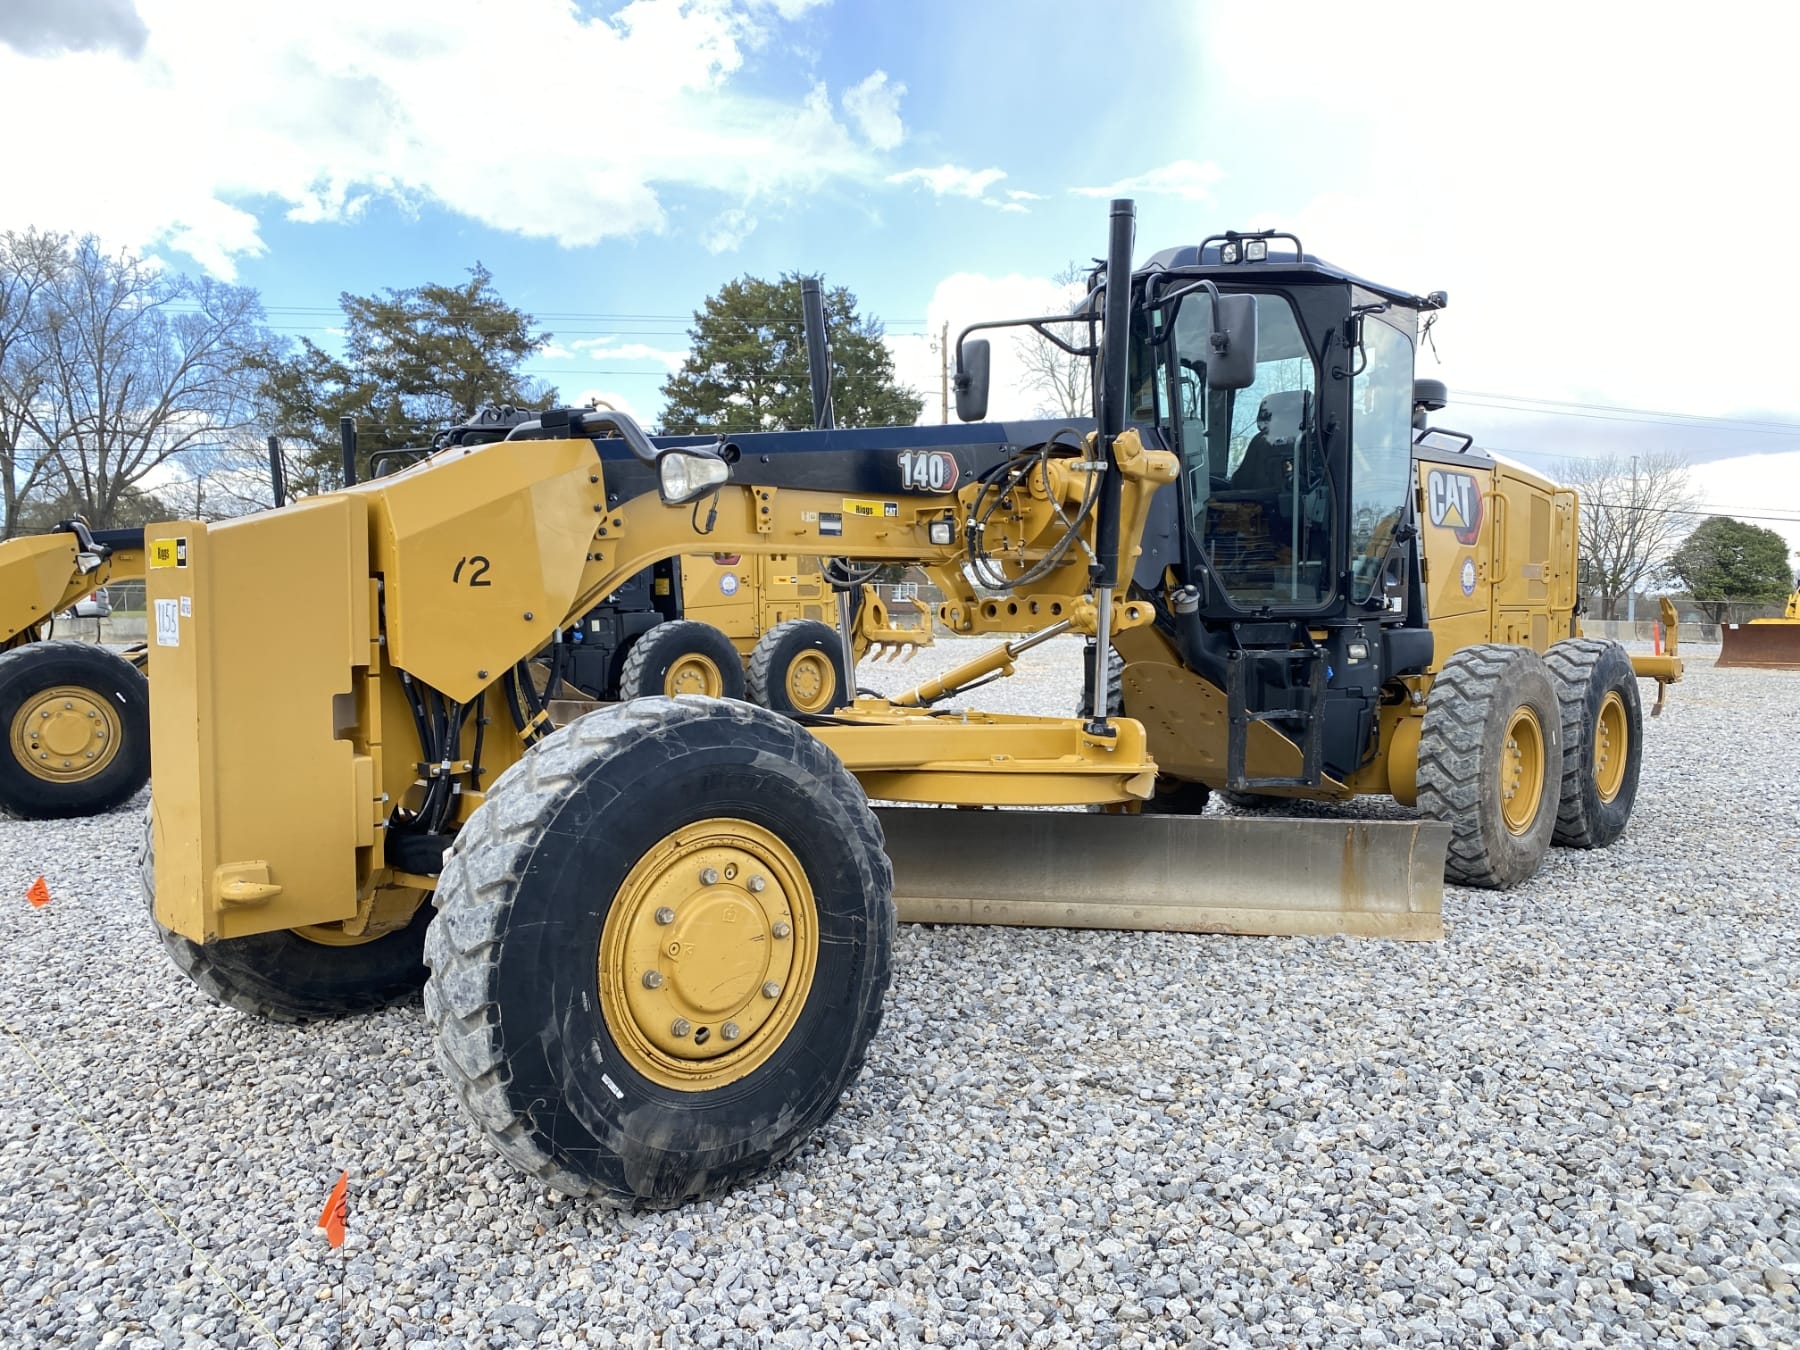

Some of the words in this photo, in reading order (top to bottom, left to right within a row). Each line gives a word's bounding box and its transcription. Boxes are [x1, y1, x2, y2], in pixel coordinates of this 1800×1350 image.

[899, 451, 944, 489] 140
[855, 504, 874, 516] Riggs
[1428, 469, 1472, 529] CAT
[452, 556, 492, 587] 12
